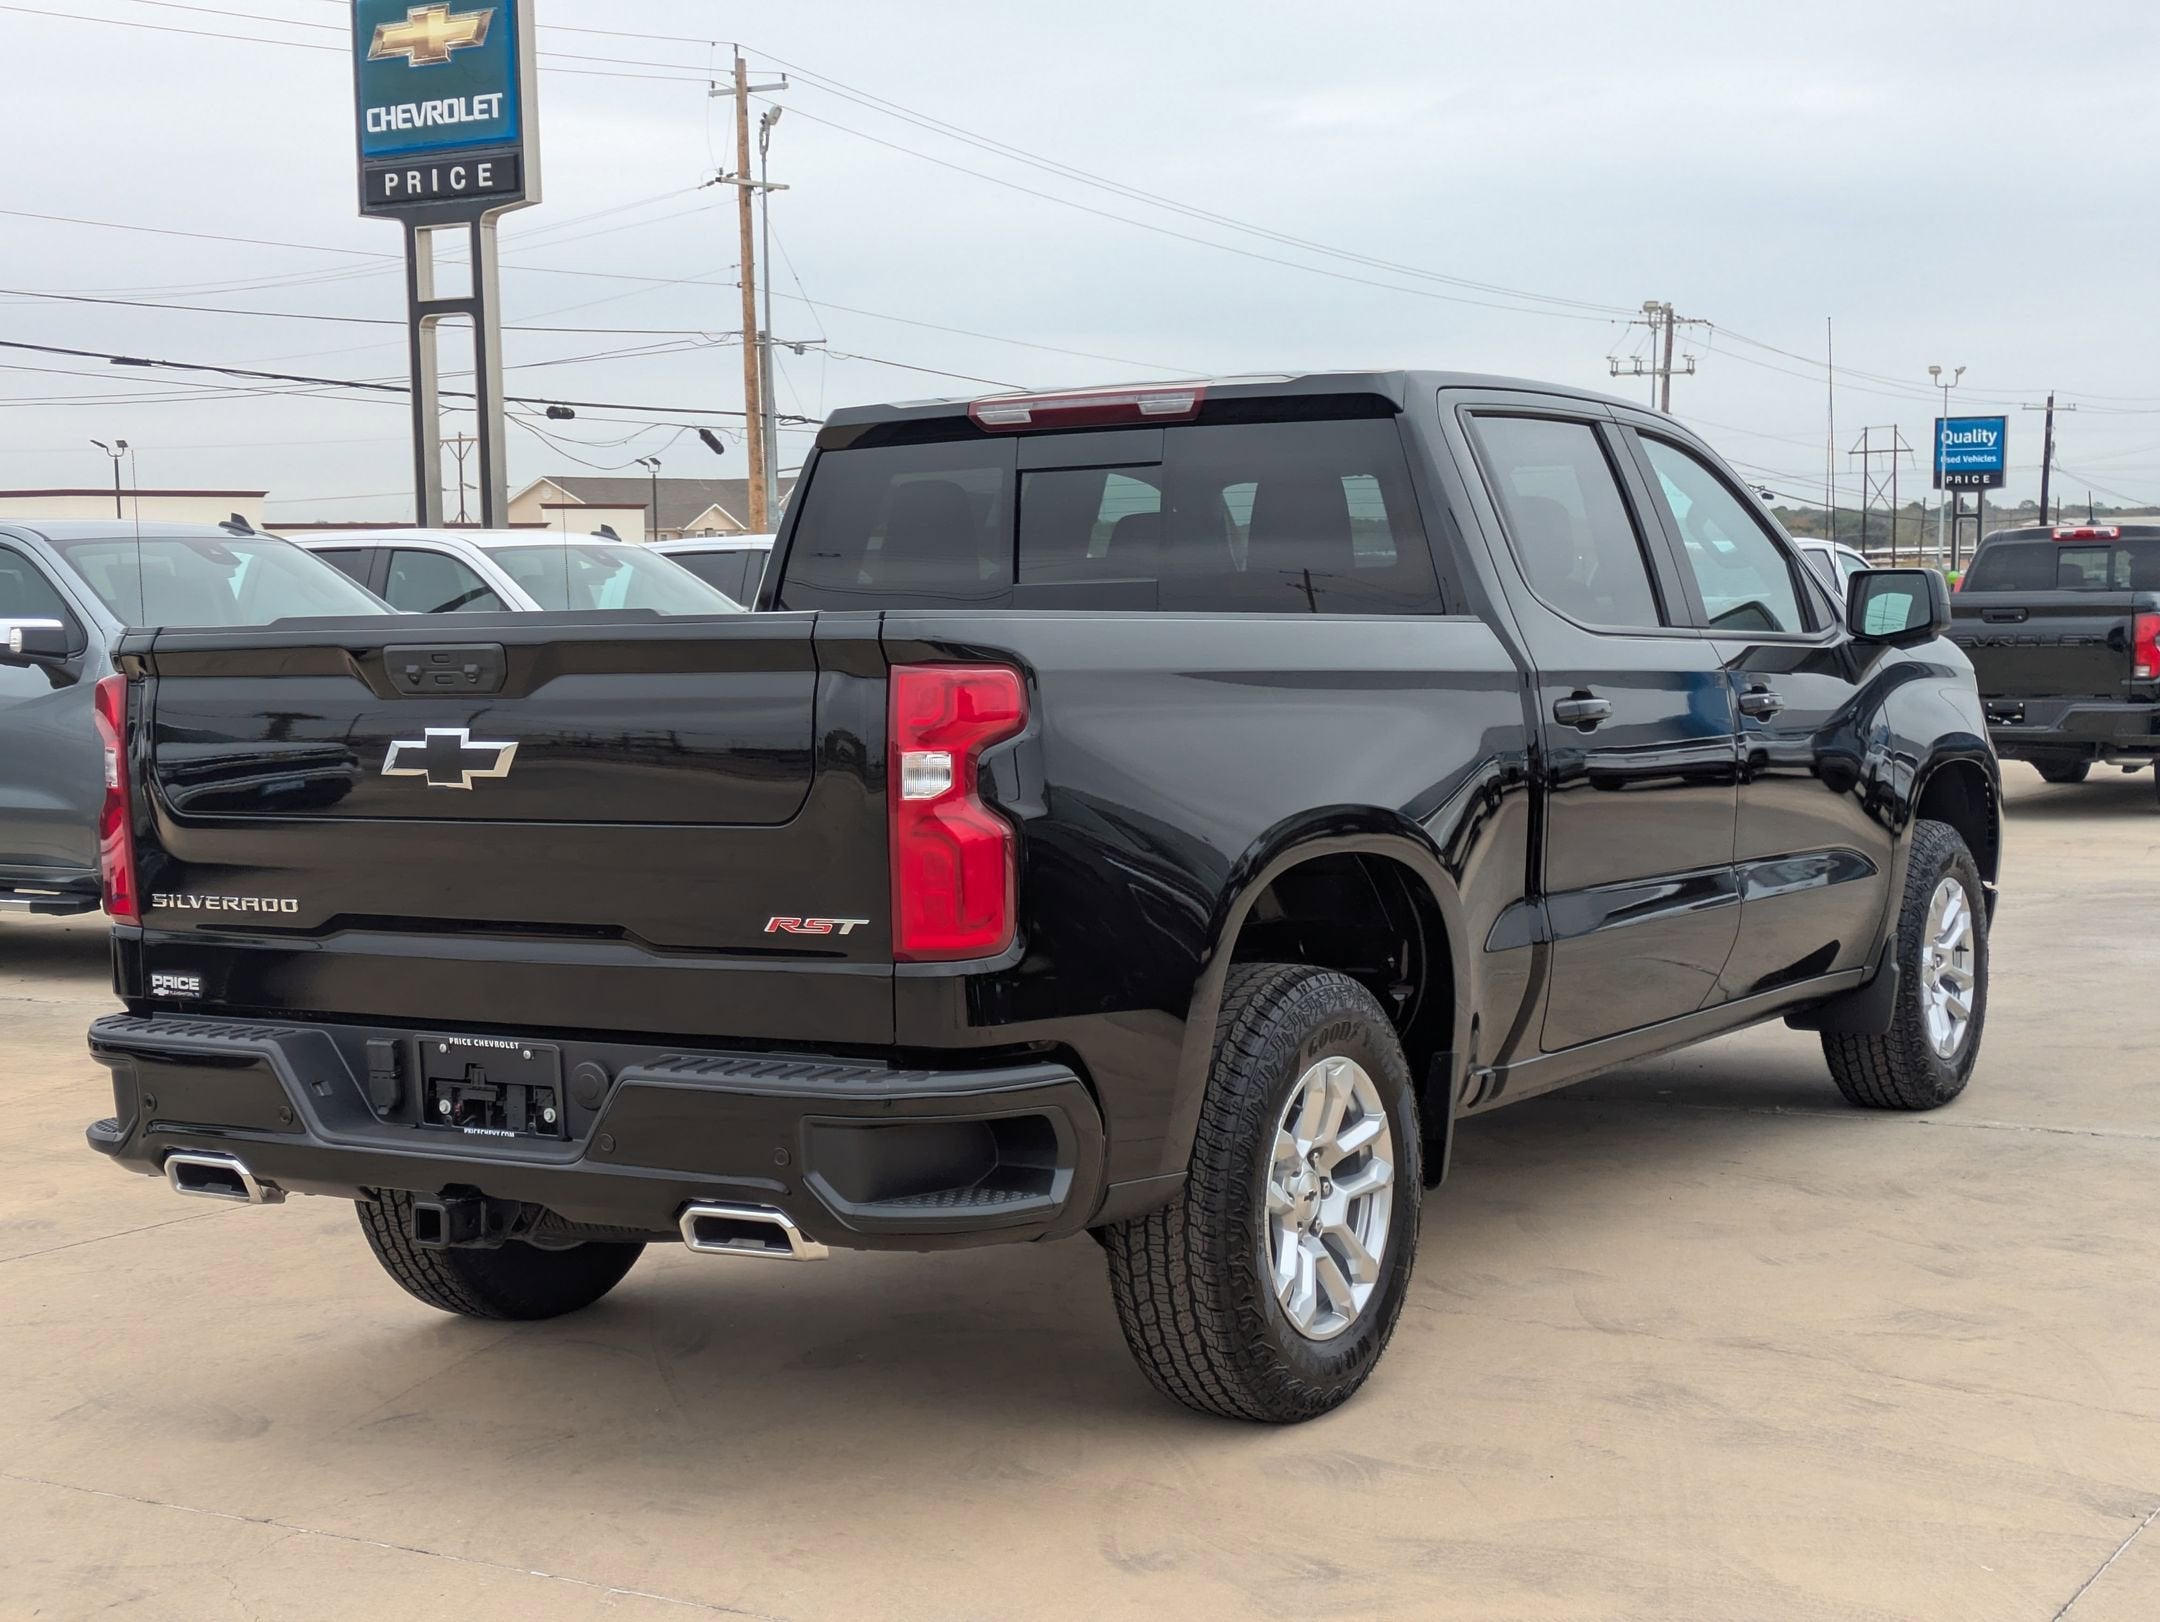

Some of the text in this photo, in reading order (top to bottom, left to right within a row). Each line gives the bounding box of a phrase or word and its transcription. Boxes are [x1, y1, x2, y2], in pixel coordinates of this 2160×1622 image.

[367, 93, 503, 132] CHEVROLET
[384, 163, 493, 196] PRICE
[1941, 428, 1998, 447] Quality
[1963, 454, 1997, 463] Vehicles
[1946, 475, 1991, 484] PRICE
[1953, 634, 2104, 647] EVROLET
[151, 893, 299, 913] SILVERADO
[763, 916, 870, 935] RST
[152, 974, 200, 990] PRICE
[449, 1037, 520, 1049] PRICE CHEVROLET
